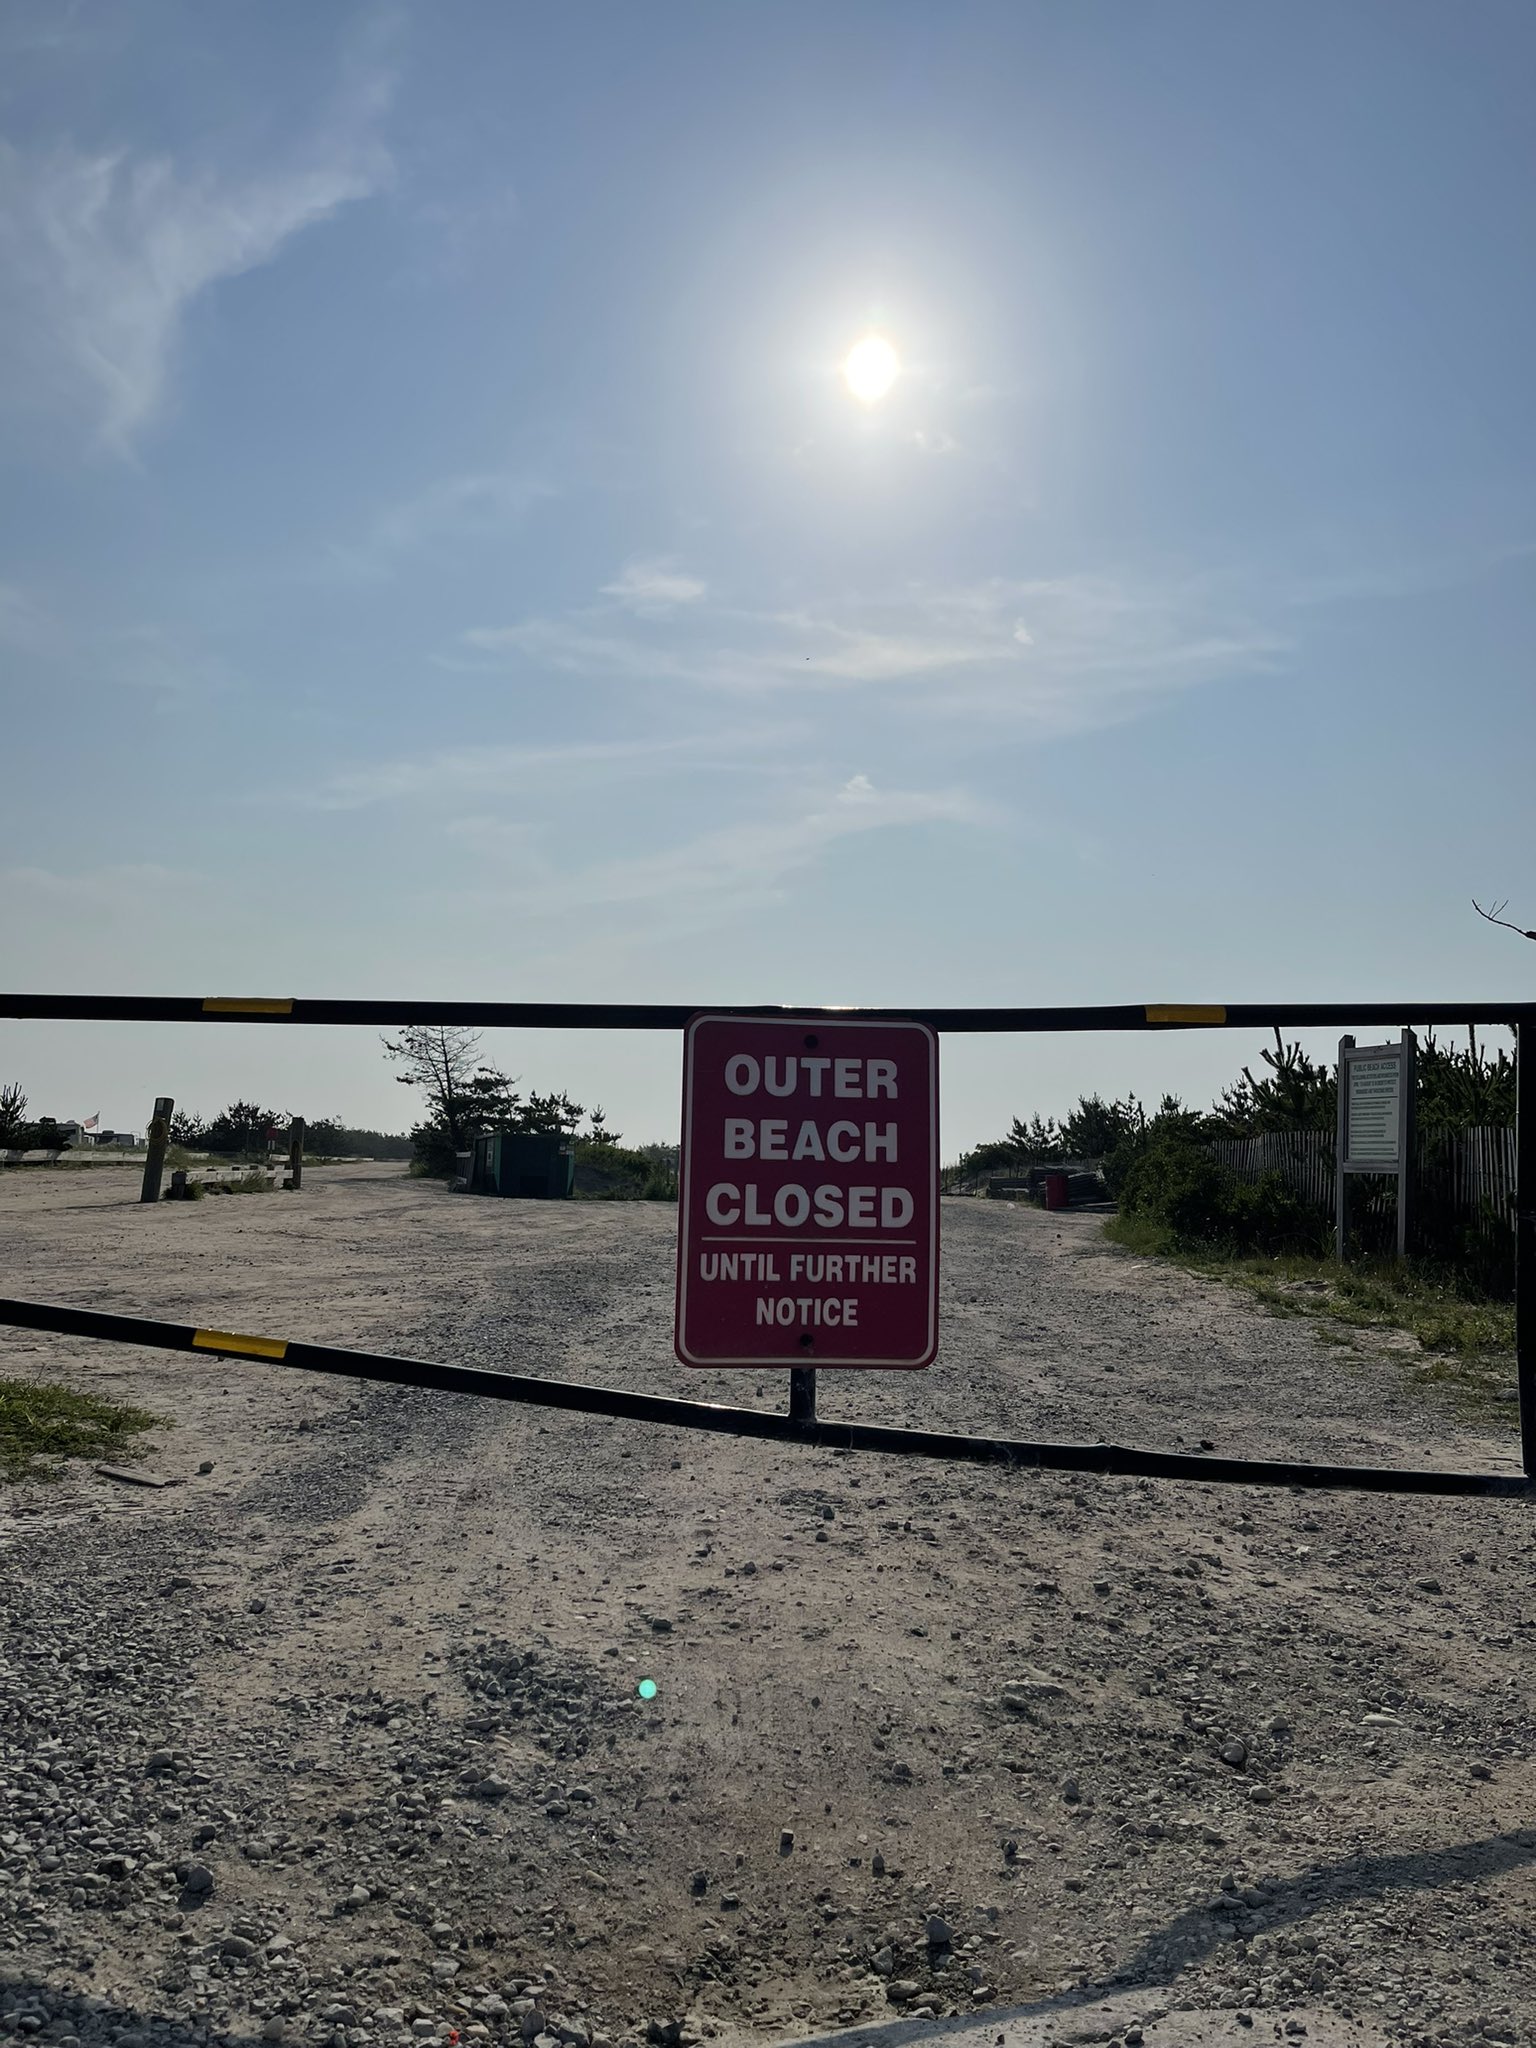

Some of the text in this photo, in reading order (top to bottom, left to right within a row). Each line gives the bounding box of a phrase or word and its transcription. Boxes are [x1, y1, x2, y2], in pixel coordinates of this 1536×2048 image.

[724, 1053, 899, 1100] OUTER
[723, 1118, 898, 1163] BEACH
[705, 1183, 915, 1229] CLOSED
[700, 1253, 917, 1284] UNTIL FURTHER
[756, 1297, 859, 1327] NOTICE
